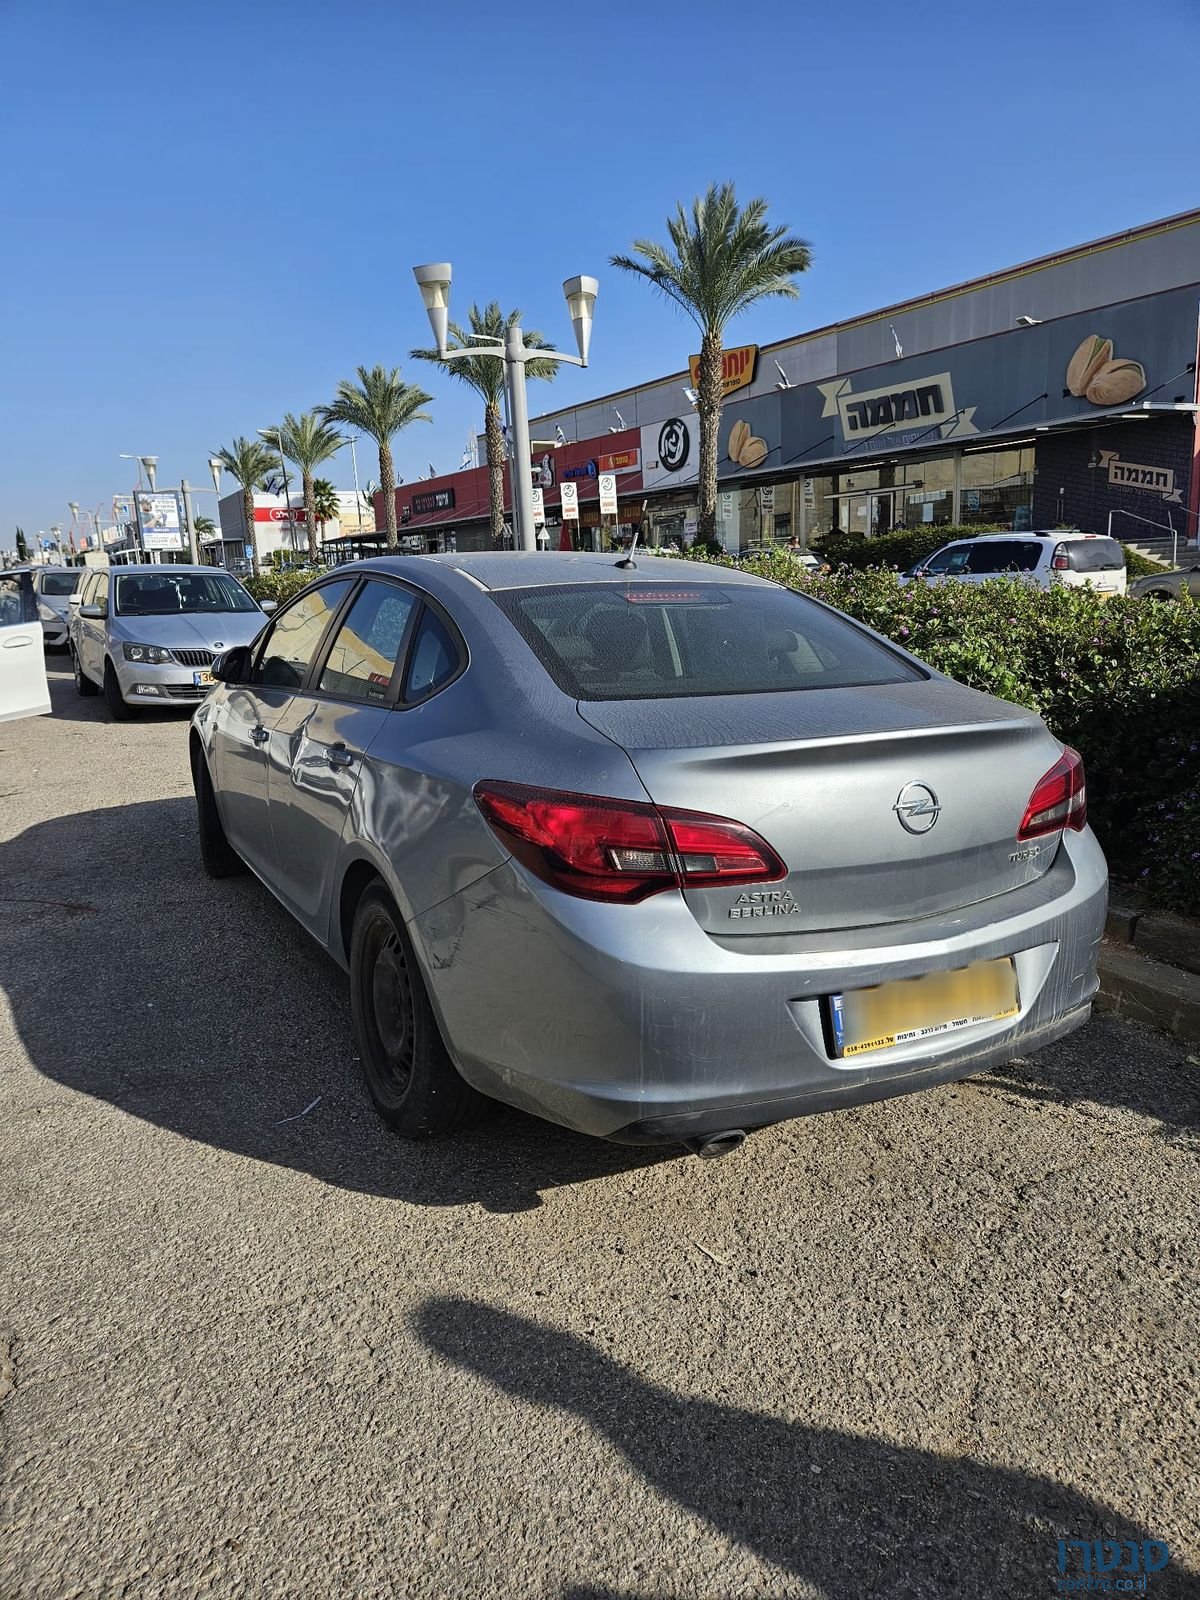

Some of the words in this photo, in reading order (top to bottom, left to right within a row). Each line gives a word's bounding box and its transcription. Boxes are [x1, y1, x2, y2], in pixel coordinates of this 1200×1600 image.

[845, 384, 945, 431] חממה
[1113, 465, 1168, 488] חממה
[735, 890, 795, 904] ASTRA
[728, 902, 801, 919] BERLINA
